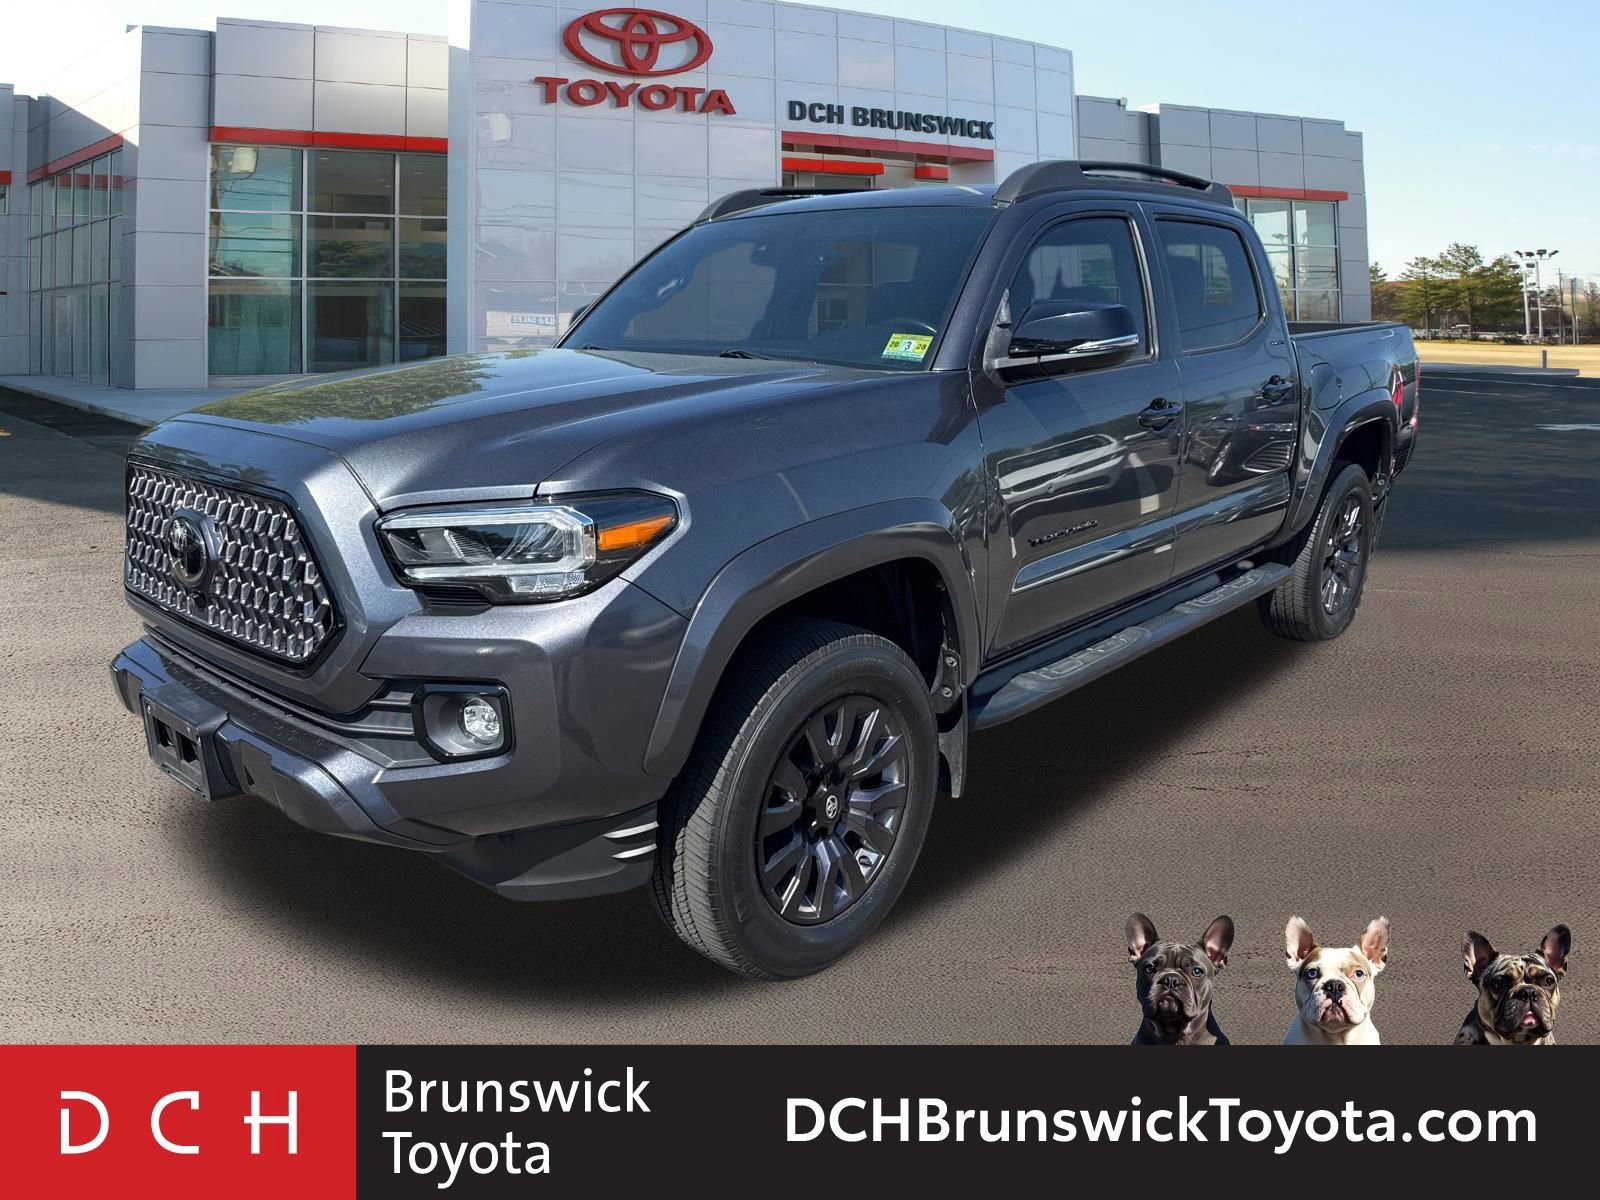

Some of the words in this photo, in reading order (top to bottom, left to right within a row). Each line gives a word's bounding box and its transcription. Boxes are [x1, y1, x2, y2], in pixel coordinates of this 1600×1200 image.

[535, 76, 736, 115] TOYOTA
[788, 100, 844, 124] DCH
[852, 106, 994, 140] BRUNSWICK
[904, 341, 912, 350] 3
